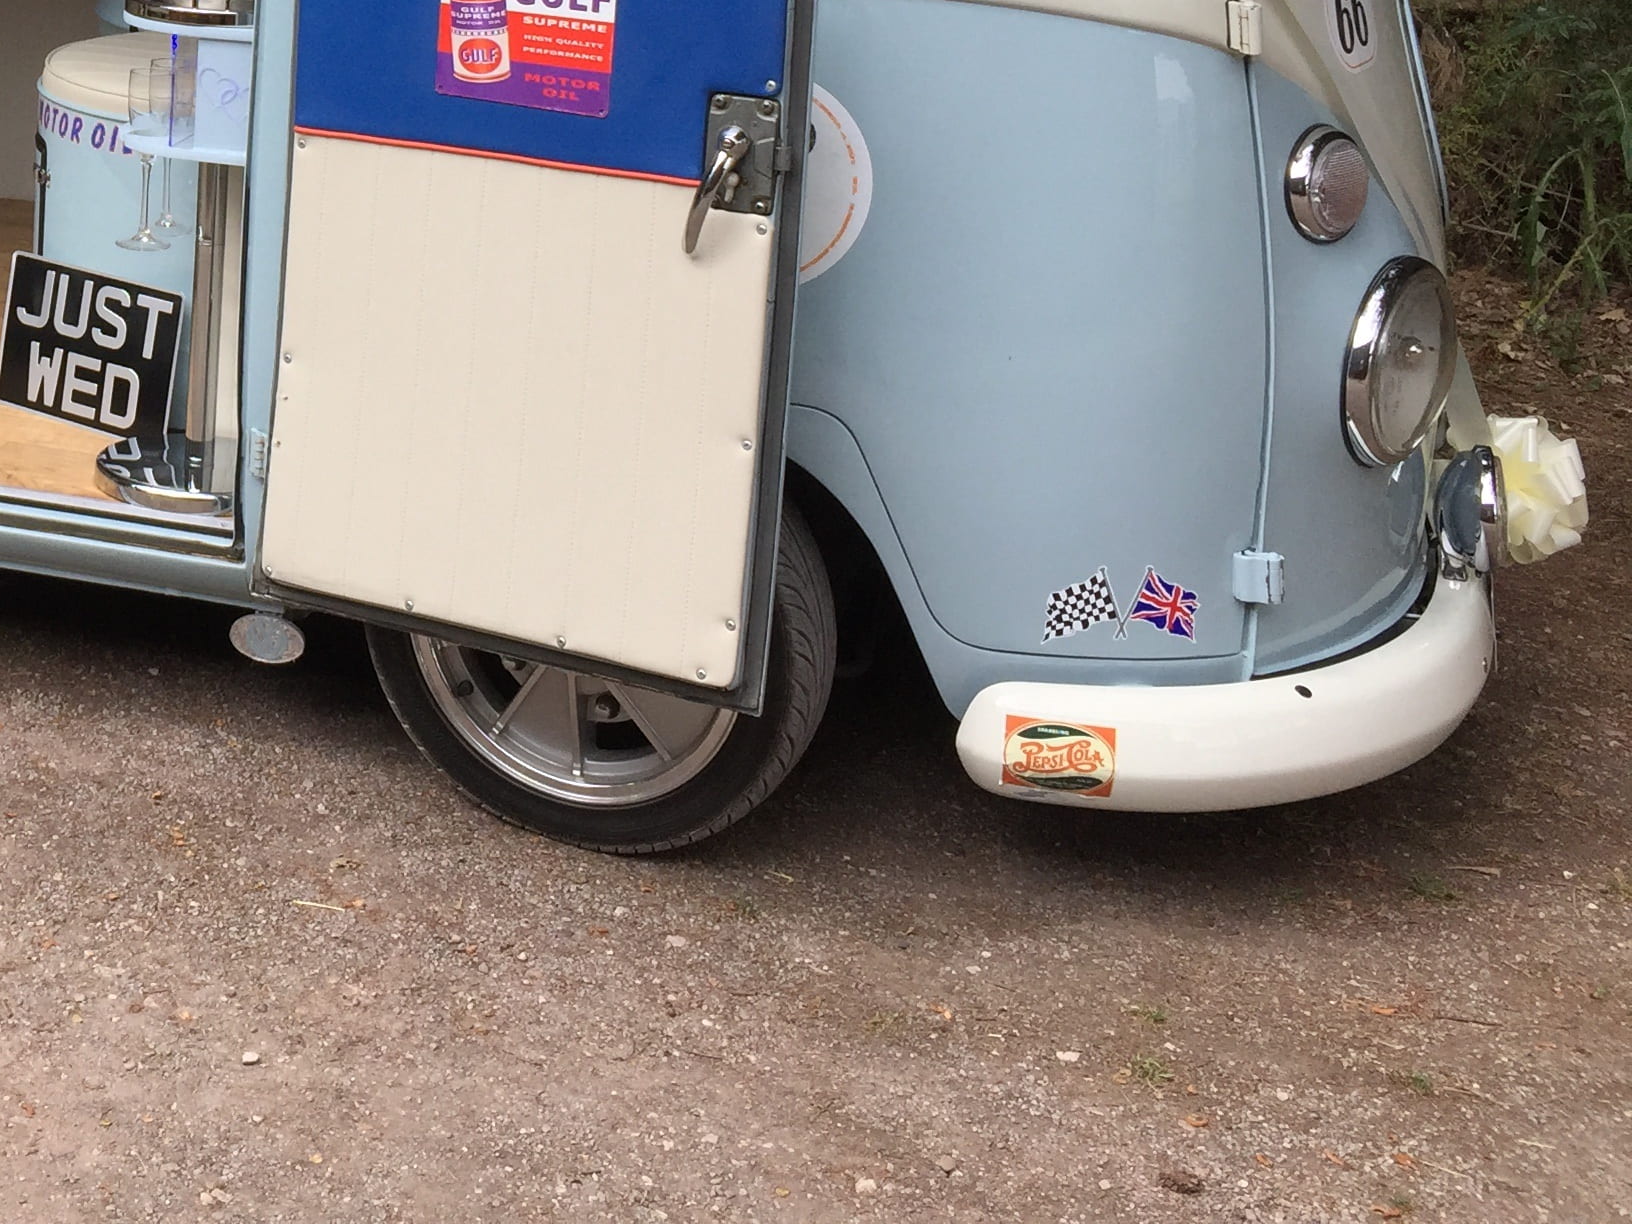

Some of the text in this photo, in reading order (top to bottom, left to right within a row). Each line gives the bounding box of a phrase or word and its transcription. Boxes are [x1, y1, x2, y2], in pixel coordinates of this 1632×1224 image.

[522, 16, 608, 33] SUPREME
[523, 34, 605, 49] HIGH QUALITY
[522, 46, 604, 62] PERFORMANCE
[524, 73, 600, 91] MOTOR
[542, 87, 580, 101] OIL
[16, 269, 174, 360] JUST
[27, 340, 140, 429] WED
[1013, 740, 1104, 774] PEPSI COLA
